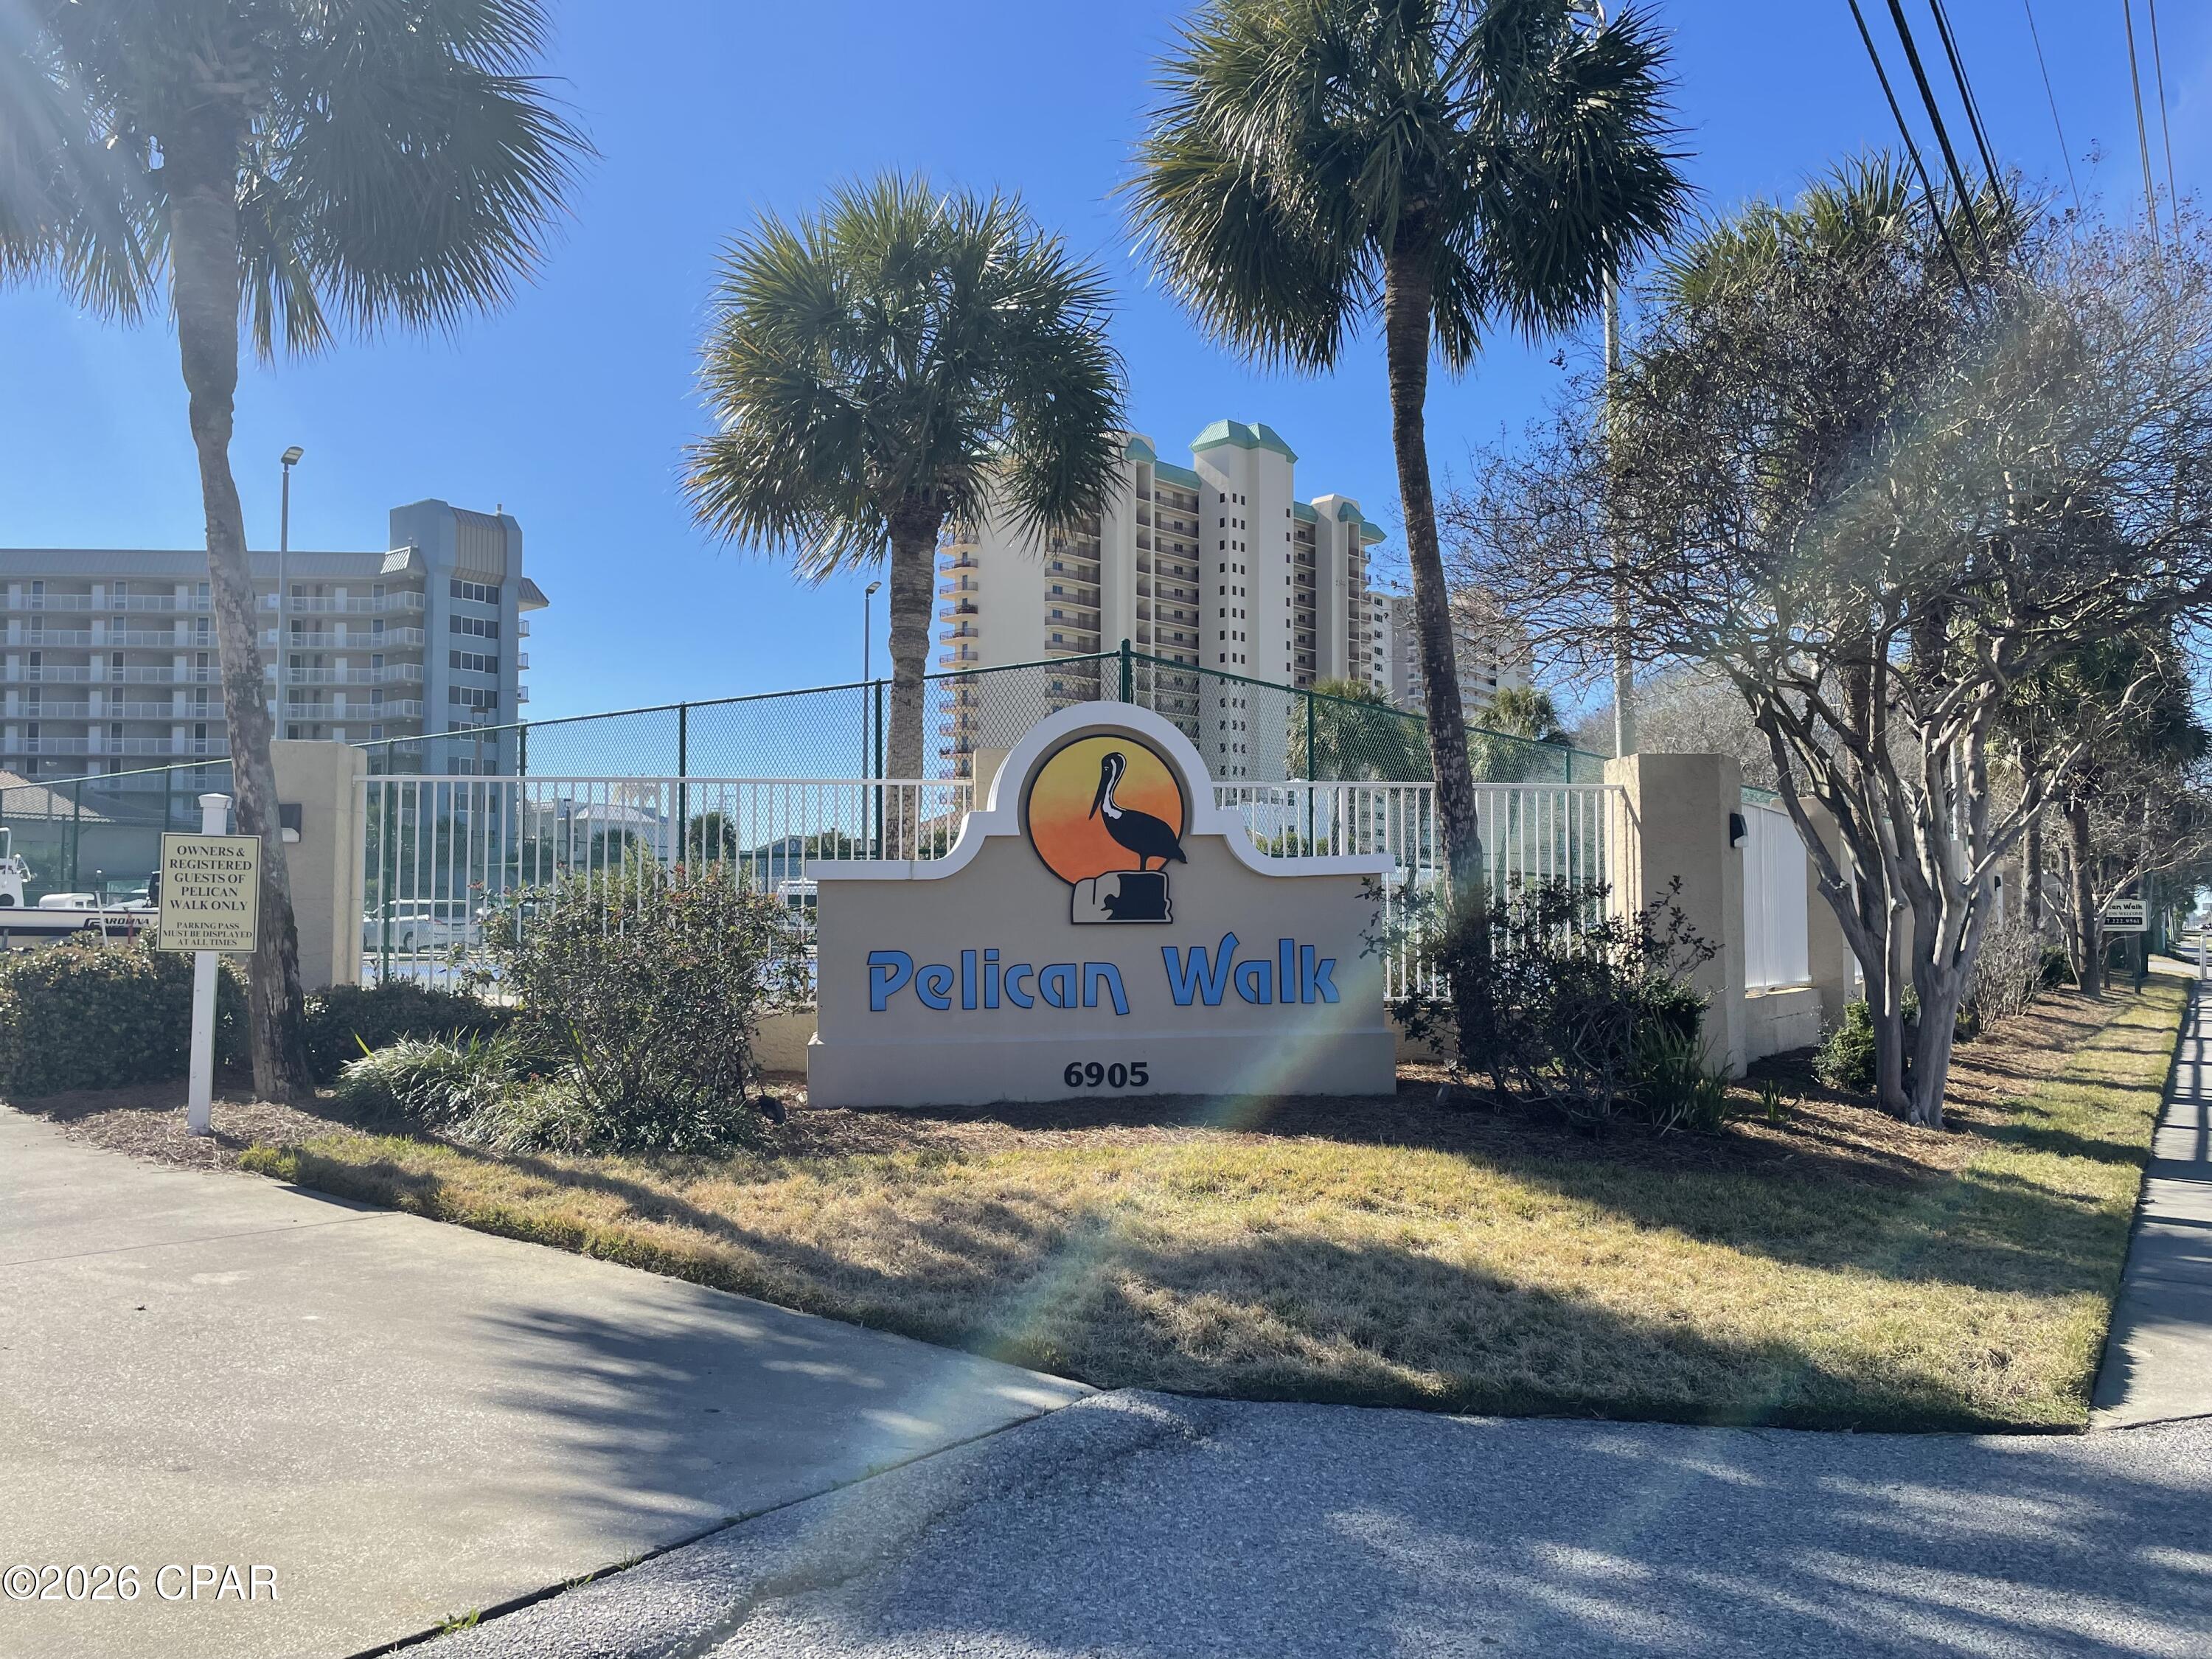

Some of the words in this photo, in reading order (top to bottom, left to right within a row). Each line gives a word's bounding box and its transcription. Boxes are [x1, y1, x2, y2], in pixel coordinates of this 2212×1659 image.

[177, 845, 234, 857] OWNERS
[236, 847, 245, 857] &
[170, 859, 252, 870] REGISTERED
[174, 873, 225, 883] GUESTS
[228, 874, 246, 884] OF
[181, 886, 238, 897] PELICAN
[170, 900, 208, 910] WALK
[211, 900, 248, 911] ONLY
[2124, 902, 2143, 910] Walk
[867, 947, 1130, 1016] Pelican
[1160, 931, 1340, 1006] Walk
[1062, 1061, 1150, 1088] 6905
